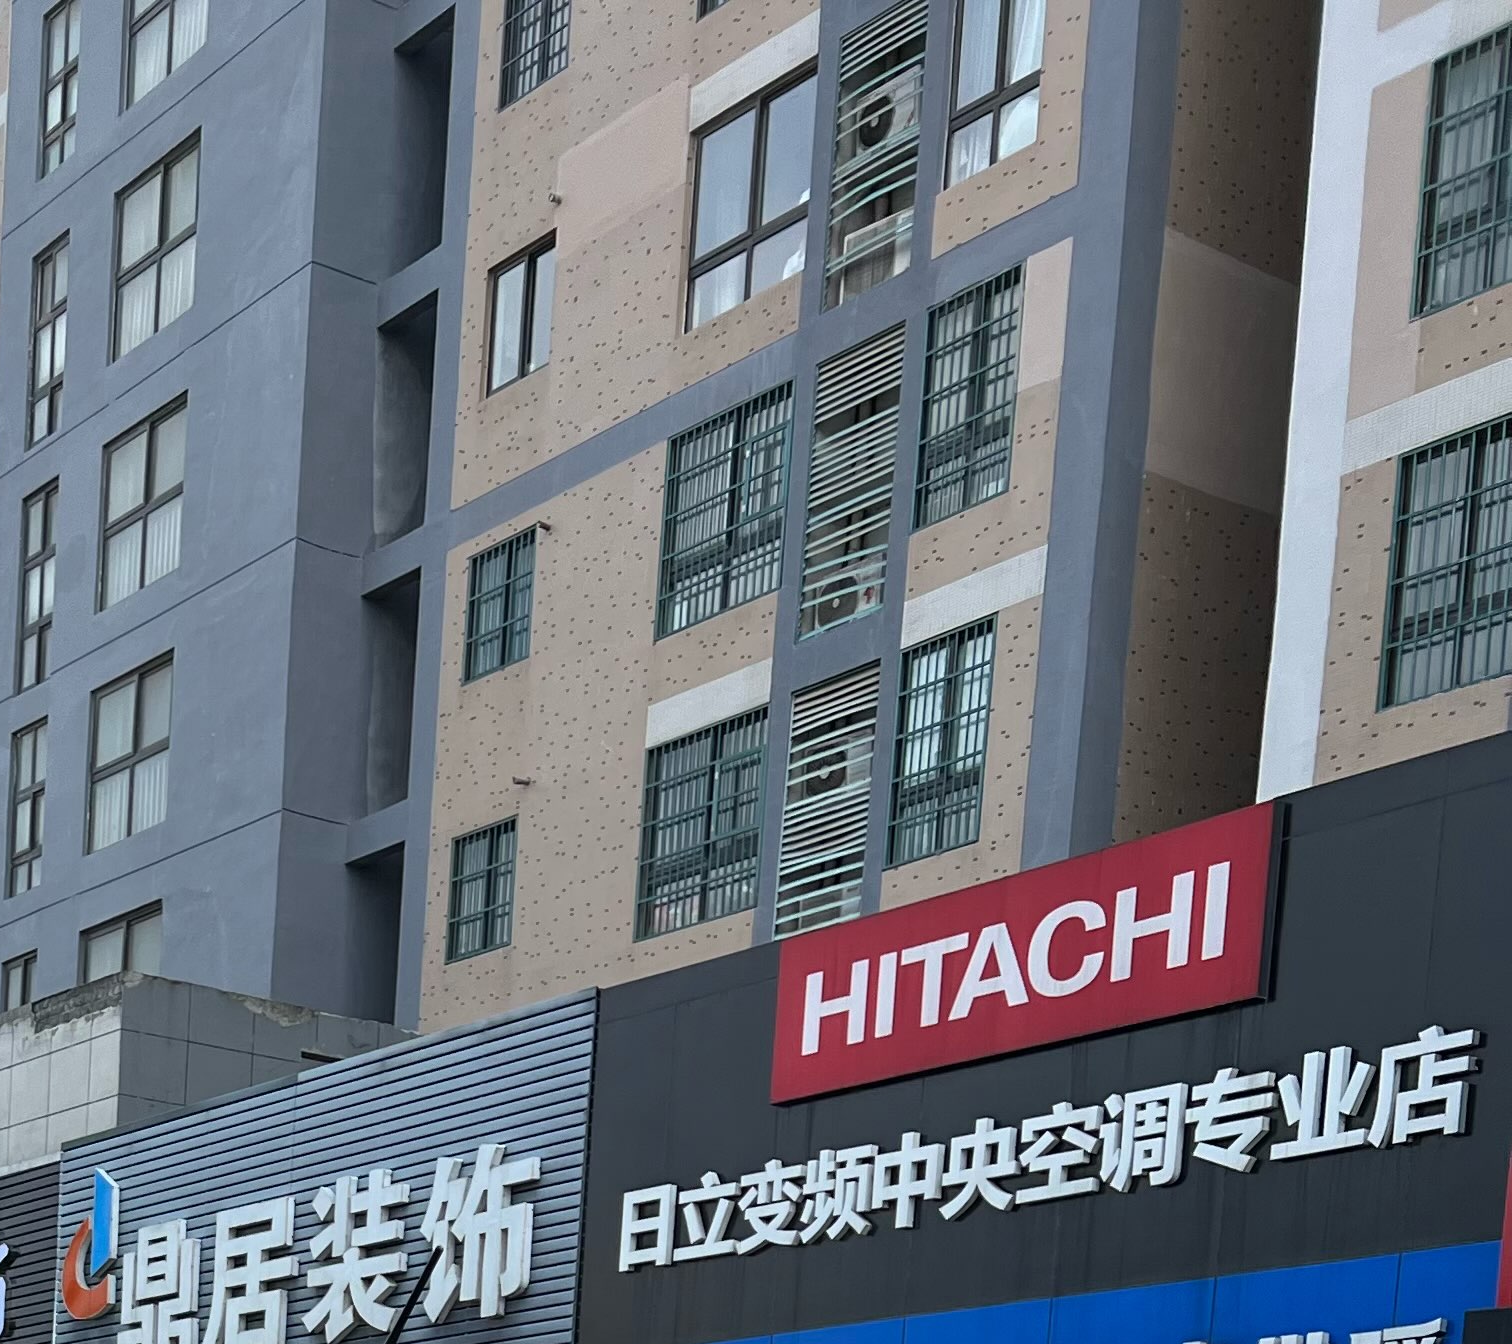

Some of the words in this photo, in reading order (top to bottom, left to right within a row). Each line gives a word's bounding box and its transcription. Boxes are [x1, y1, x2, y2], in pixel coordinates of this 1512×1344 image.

[800, 861, 1232, 1056] HITACHI
[618, 1024, 1483, 1273] 日立变频中央空调专业店
